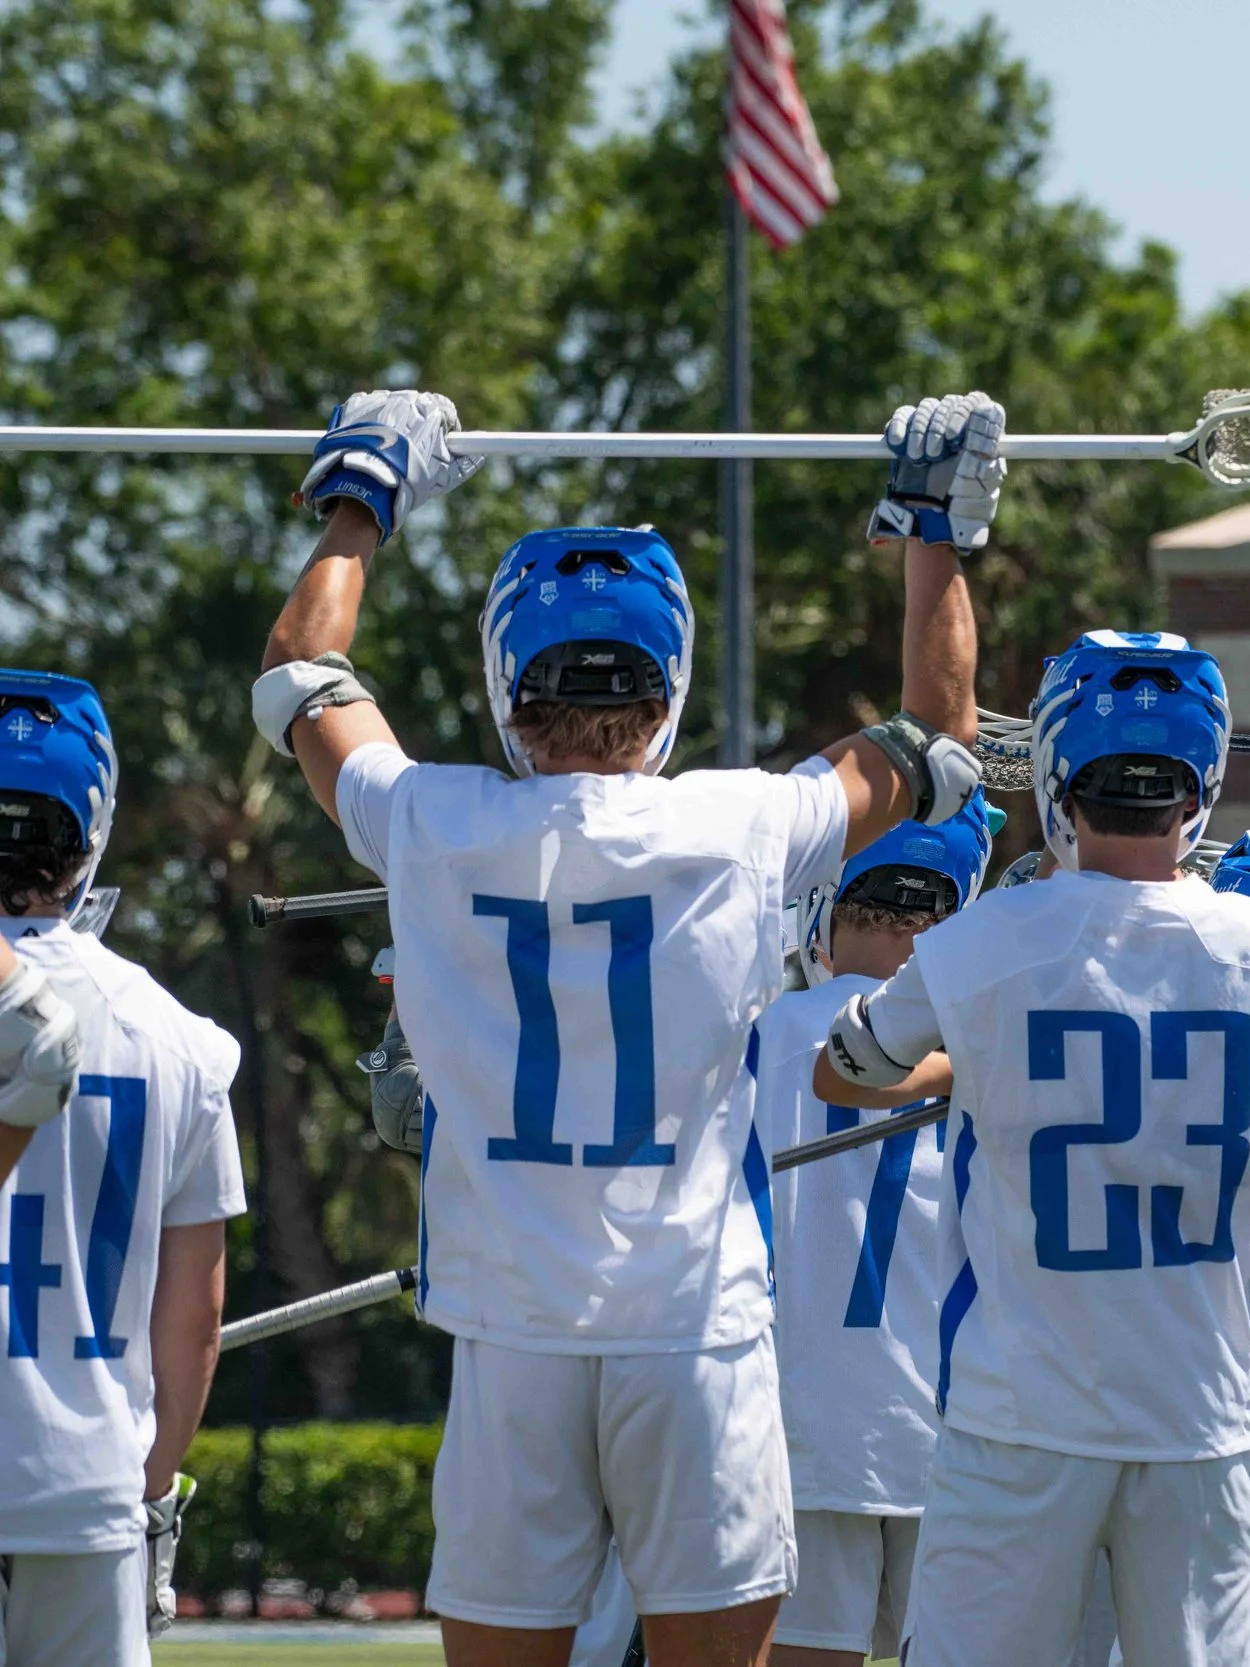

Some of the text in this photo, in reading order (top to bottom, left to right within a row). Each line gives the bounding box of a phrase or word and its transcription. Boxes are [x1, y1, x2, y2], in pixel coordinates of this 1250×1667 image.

[472, 894, 676, 1167] 11
[831, 1032, 866, 1076] STX
[827, 1096, 945, 1328] 7
